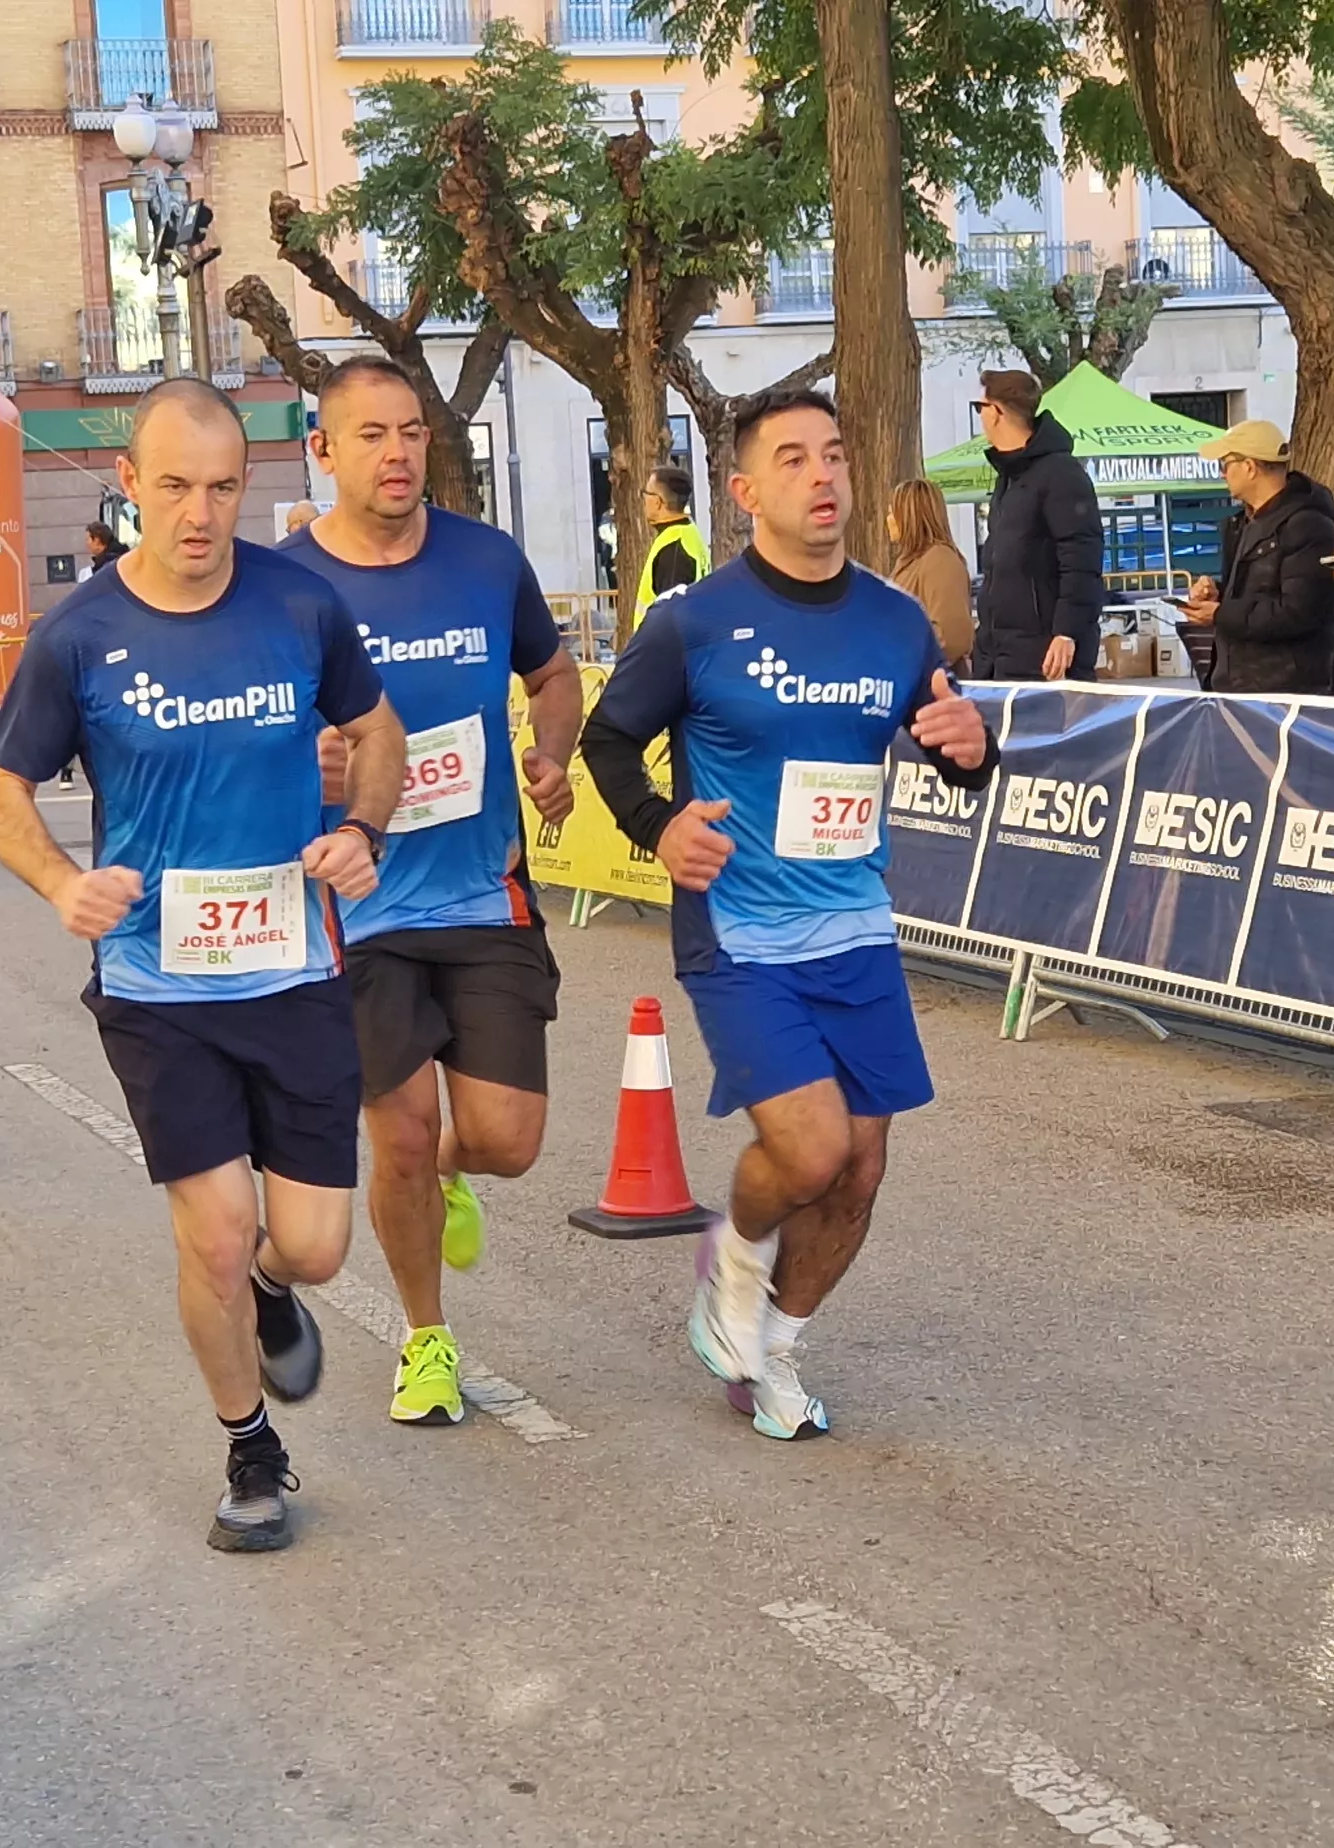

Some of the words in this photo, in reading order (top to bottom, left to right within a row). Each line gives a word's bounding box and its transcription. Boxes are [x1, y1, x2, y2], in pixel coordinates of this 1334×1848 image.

[1194, 376, 1204, 390] 2
[1095, 424, 1188, 436] FARTLECK
[1108, 436, 1195, 447] SPORT
[1098, 456, 1218, 482] AVITUALLAMIENTO
[363, 626, 488, 665] CleanPill
[154, 682, 296, 730] CleanPill
[776, 674, 894, 709] CleanPill
[910, 763, 979, 820] ESIC
[811, 796, 873, 825] 370
[1024, 777, 1109, 838] ESIC
[812, 827, 865, 841] MIGUEL
[1157, 793, 1252, 858] ESIC
[815, 842, 838, 857] 8K
[197, 896, 269, 931] 371
[206, 950, 233, 965] 8K
